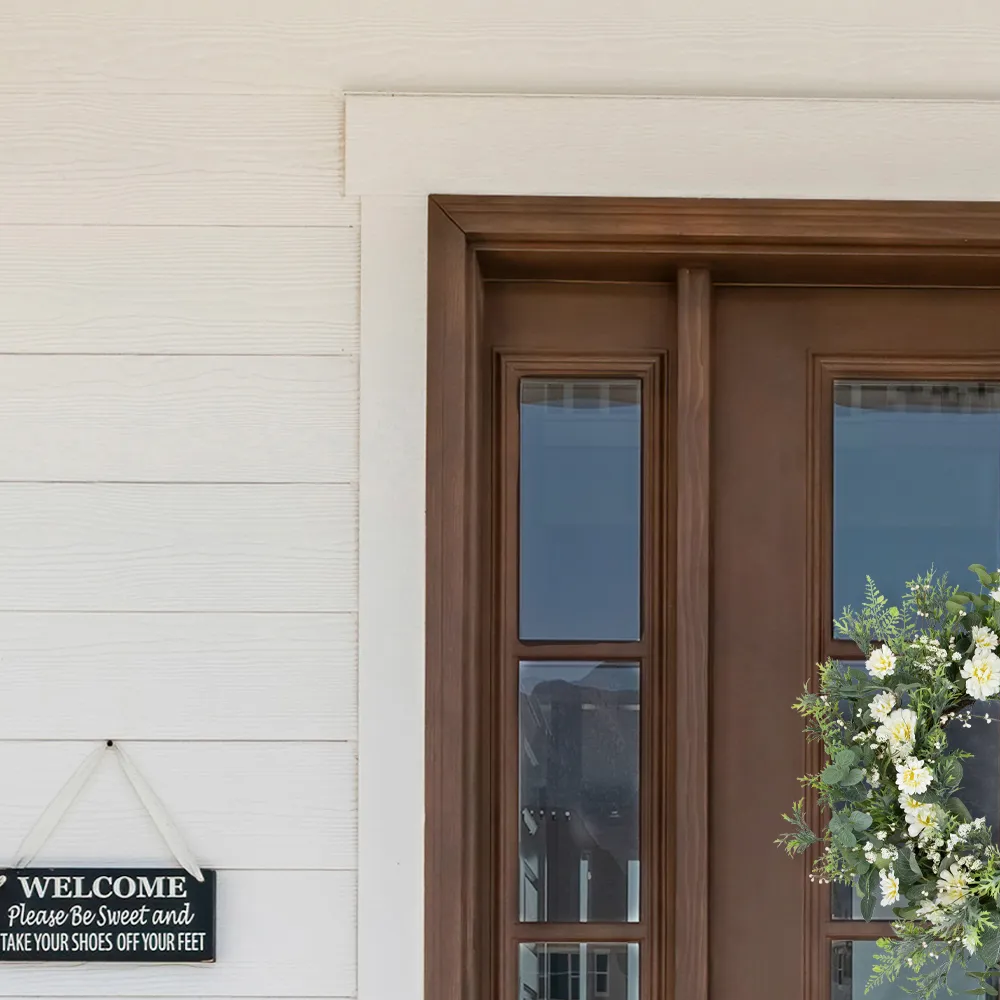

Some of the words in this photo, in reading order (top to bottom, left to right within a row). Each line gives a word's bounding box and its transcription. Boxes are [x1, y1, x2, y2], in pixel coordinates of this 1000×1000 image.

[17, 876, 187, 898] WELCOME
[8, 903, 68, 927] Please
[70, 905, 96, 926] Be
[97, 905, 150, 926] Sweet
[152, 903, 195, 925] and
[0, 933, 32, 951] TAKE
[34, 933, 69, 951] YOUR
[71, 933, 113, 951] SHOES
[117, 933, 140, 951] OFF
[142, 933, 176, 951] YOUR
[178, 933, 206, 951] FEET
